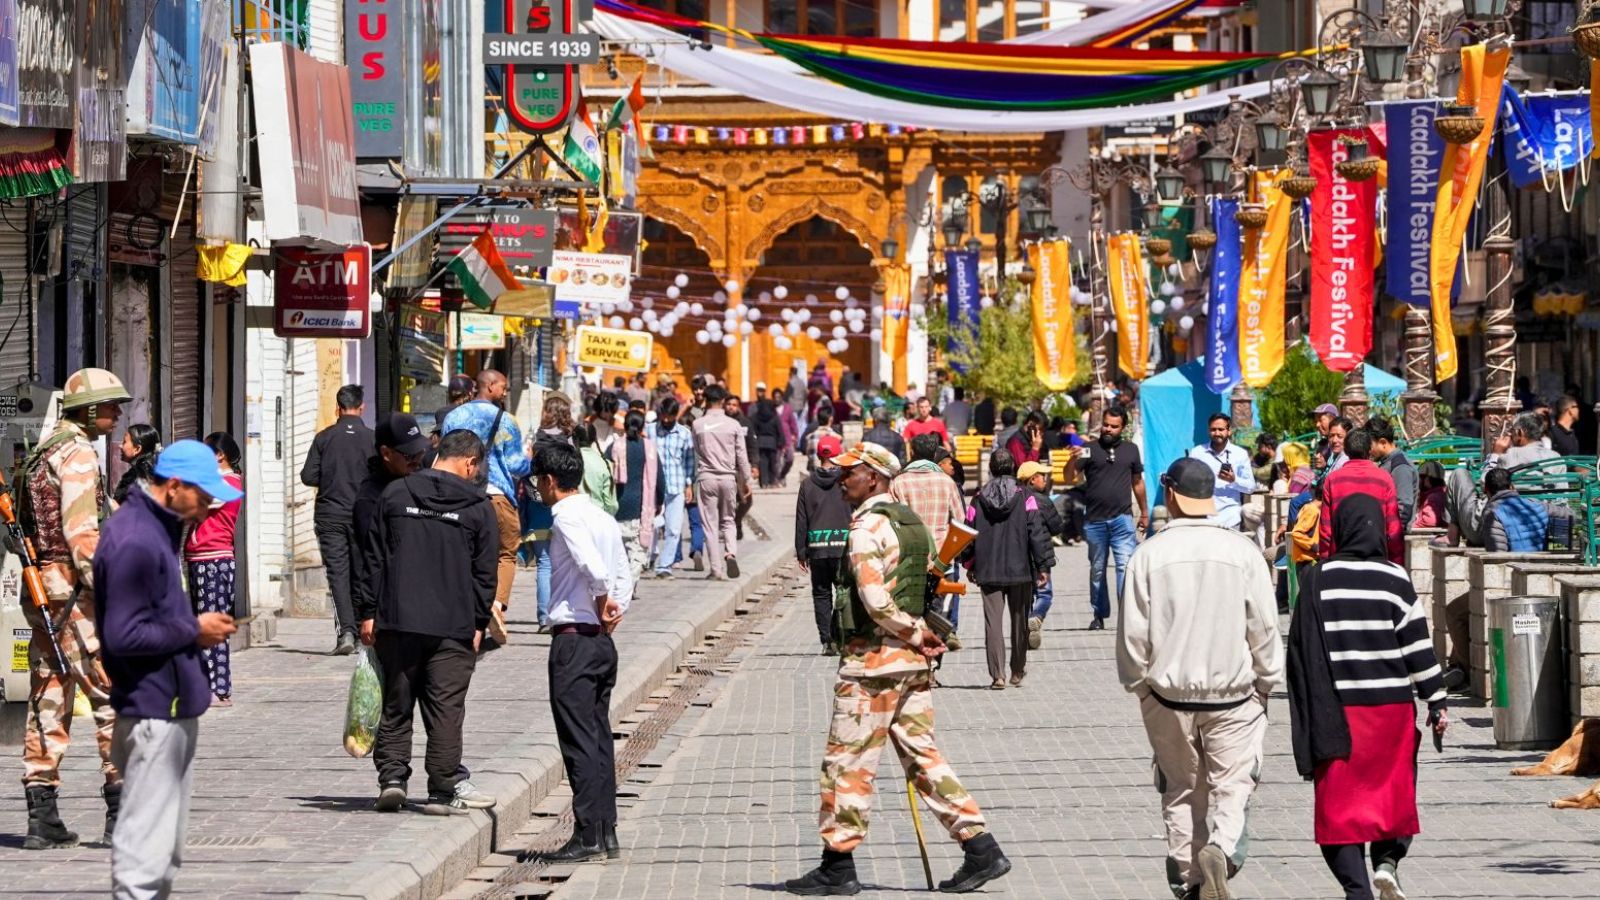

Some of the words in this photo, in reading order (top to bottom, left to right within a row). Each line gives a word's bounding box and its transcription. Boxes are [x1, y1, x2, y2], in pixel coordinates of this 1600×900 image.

[489, 41, 544, 57] SINCE
[549, 41, 591, 57] 1939
[522, 88, 559, 99] PURE
[353, 103, 396, 116] PURE
[528, 104, 555, 116] VEG
[359, 119, 393, 132] VEG
[1409, 106, 1438, 195] Laadakh
[504, 215, 520, 224] TO
[1409, 202, 1435, 298] Festival
[291, 260, 358, 285] ATM
[1329, 257, 1355, 359] Festival
[303, 317, 330, 326] ICICI
[331, 318, 357, 327] Bank
[587, 334, 612, 345] TAXI
[1246, 288, 1267, 380] Festival
[585, 347, 630, 360] SERVICE
[0, 406, 17, 417] OES
[405, 506, 420, 515] THE
[441, 512, 460, 521] FACE
